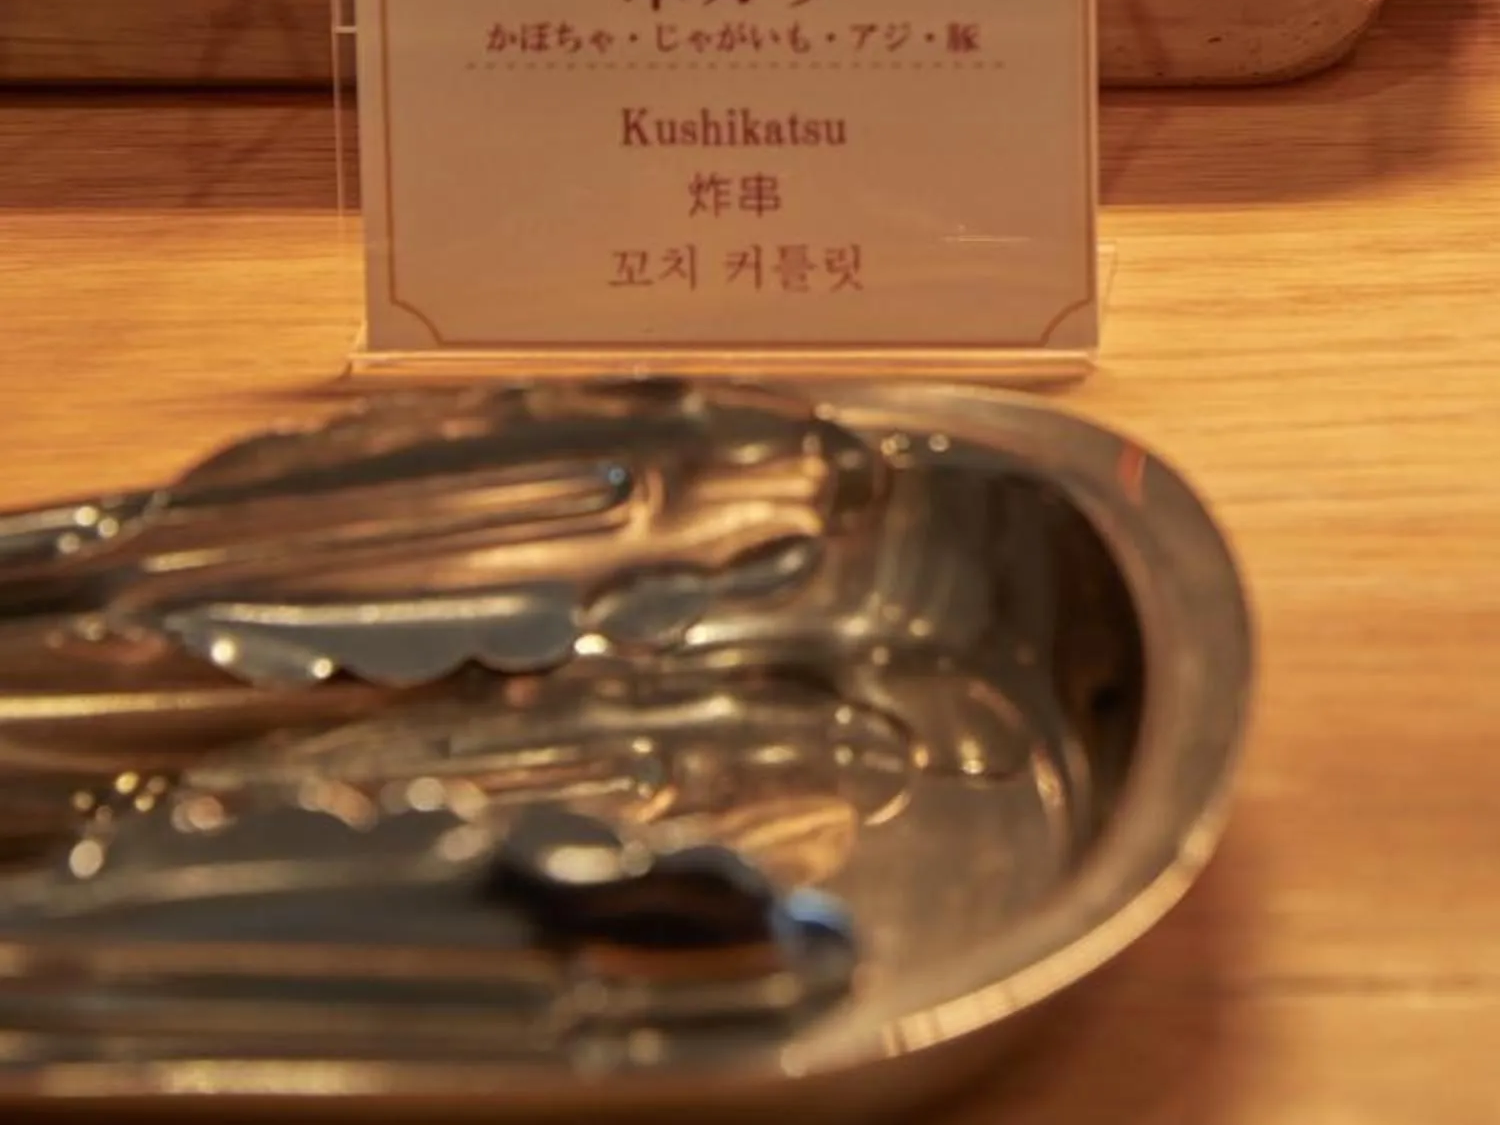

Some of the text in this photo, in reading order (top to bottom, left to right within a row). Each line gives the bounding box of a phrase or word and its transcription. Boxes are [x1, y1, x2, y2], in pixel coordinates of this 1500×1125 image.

[620, 107, 849, 148] Kushikatsu
[687, 172, 783, 218] 炸串
[608, 244, 700, 291] 꼬치
